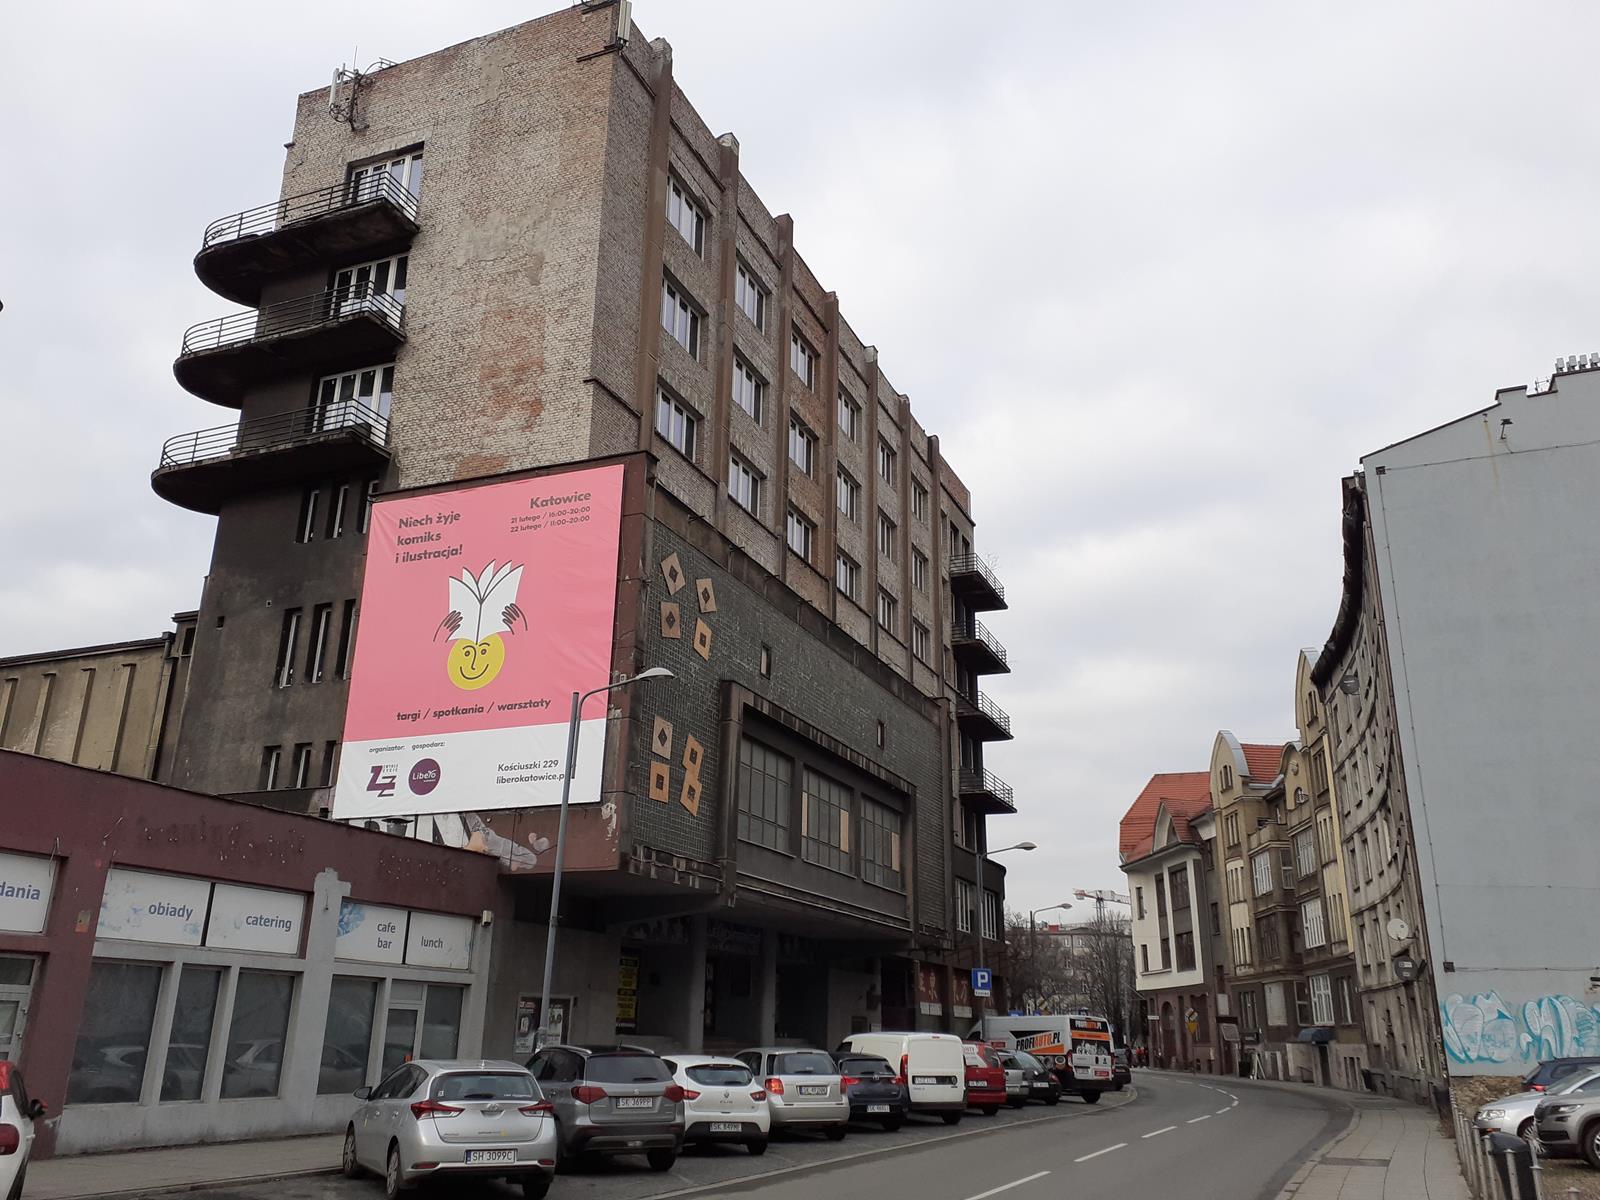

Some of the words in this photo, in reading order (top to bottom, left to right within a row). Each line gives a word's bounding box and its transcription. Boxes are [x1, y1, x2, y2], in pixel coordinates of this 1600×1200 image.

[530, 491, 592, 509] Katowice
[399, 514, 433, 529] Niech
[436, 510, 461, 526] żyje
[519, 514, 541, 522] lutego
[520, 523, 542, 531] lutego
[397, 531, 442, 546] komiks
[395, 552, 400, 564] i
[402, 543, 463, 563] ilustracja!
[396, 709, 421, 722] targi
[432, 703, 485, 719] spotkania
[497, 698, 551, 712] warsztaty
[497, 760, 541, 772] Kościuszki
[542, 759, 559, 769] 229
[496, 771, 565, 784] liberokatowice.p
[148, 901, 194, 921] obiady
[245, 913, 293, 932] catering
[377, 922, 396, 933] cafe
[377, 937, 393, 949] bar
[420, 936, 444, 949] lunch
[977, 971, 989, 988] P
[1016, 1031, 1061, 1051] PROFIAUTO.PL
[472, 1151, 484, 1162] SH
[486, 1151, 513, 1161] 3099C
